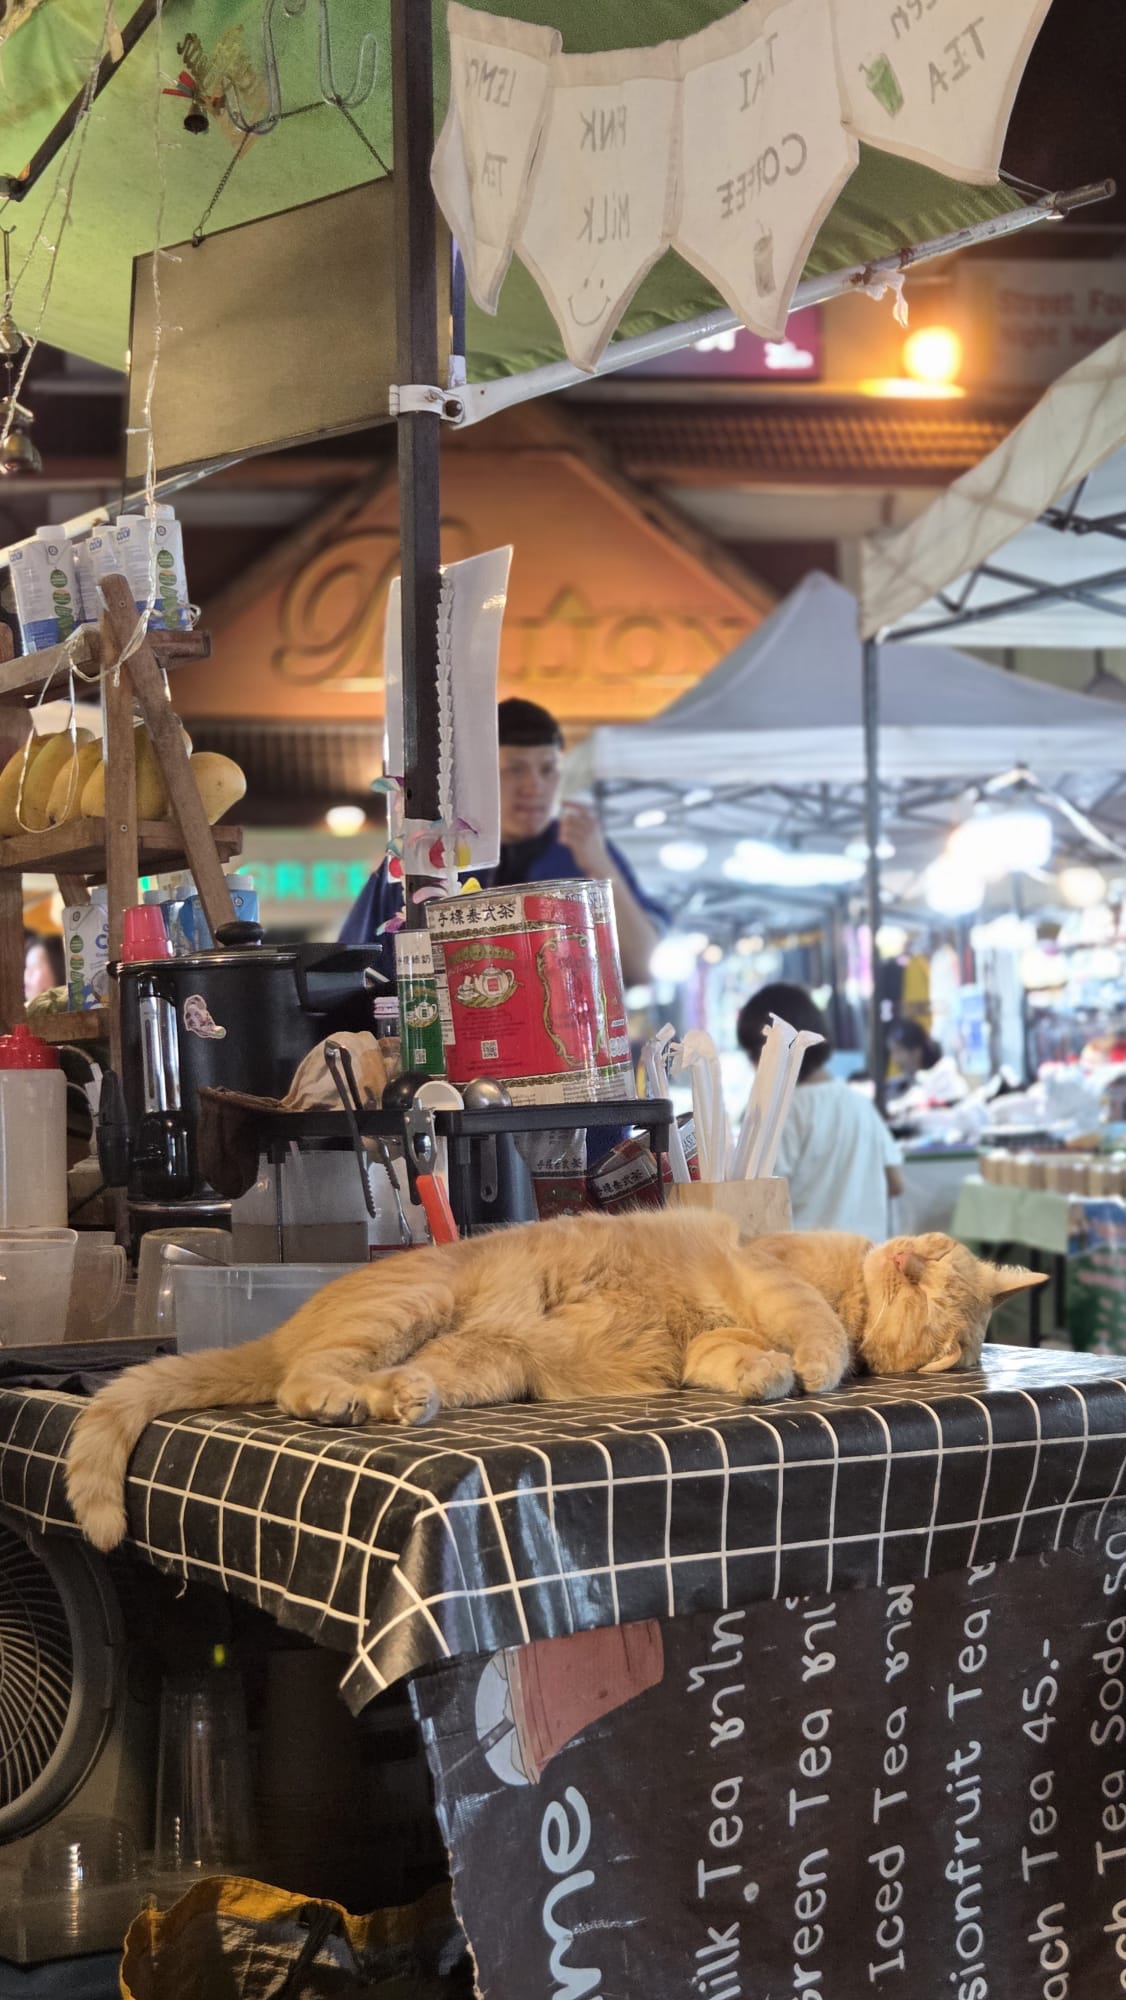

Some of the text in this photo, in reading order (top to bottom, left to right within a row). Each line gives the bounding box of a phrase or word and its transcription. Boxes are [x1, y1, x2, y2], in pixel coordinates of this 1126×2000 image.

[948, 1608, 991, 1720] Tea
[1022, 1638, 1060, 1745] 45.-
[1089, 1615, 1126, 1746] Soda
[788, 1708, 833, 1827] Tea
[872, 1705, 909, 1825] Tea
[1095, 1769, 1126, 1875] Tea
[697, 1775, 744, 1899] Tea
[1021, 1770, 1060, 1883] Tea
[694, 1921, 743, 2000] ilk
[867, 1844, 905, 1983] Iced
